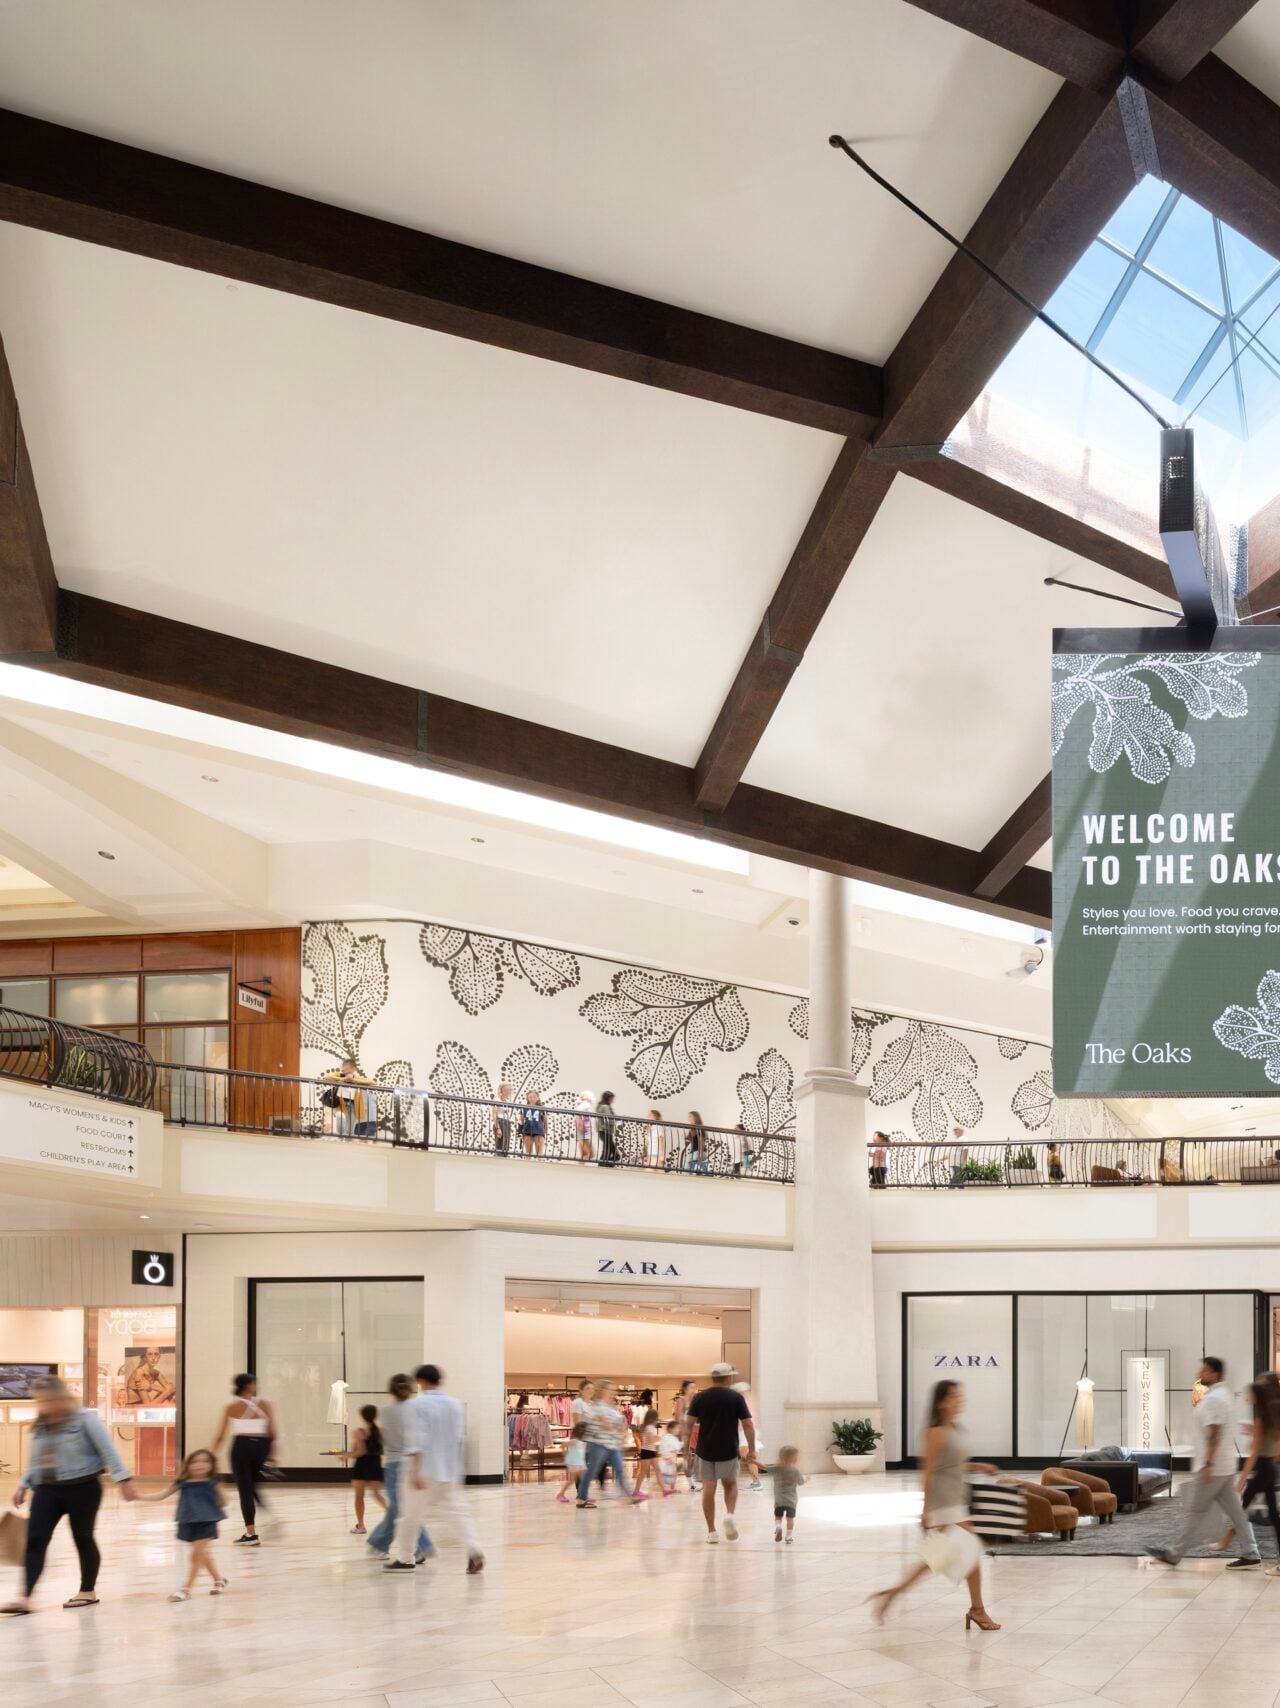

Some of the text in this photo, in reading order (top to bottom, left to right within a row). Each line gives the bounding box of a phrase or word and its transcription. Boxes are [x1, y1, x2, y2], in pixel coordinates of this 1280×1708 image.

[1082, 813, 1235, 845] WELCOME
[1082, 855, 1120, 886] TO
[1136, 854, 1195, 885] THE
[1082, 907, 1120, 921] Styles
[1123, 909, 1146, 921] you
[1149, 906, 1178, 918] love.
[1181, 906, 1212, 918] Food
[1216, 908, 1239, 920] you
[1082, 924, 1172, 936] Entertainment
[1175, 923, 1212, 935] worth
[1215, 922, 1262, 937] staying
[1085, 1042, 1192, 1064] The Oaks
[28, 1100, 127, 1127] MACY'S WOMEN'S & KIDS
[525, 1109, 540, 1121] 44
[76, 1125, 127, 1141] FOOD COURT
[80, 1142, 127, 1156] RESTROOMS
[40, 1150, 127, 1171] CHILDREN'S PLAY AREA
[598, 1259, 682, 1276] ZARA
[934, 1355, 1000, 1367] ZARA
[1140, 1361, 1151, 1389] NEW
[1142, 1392, 1151, 1449] SEASON
